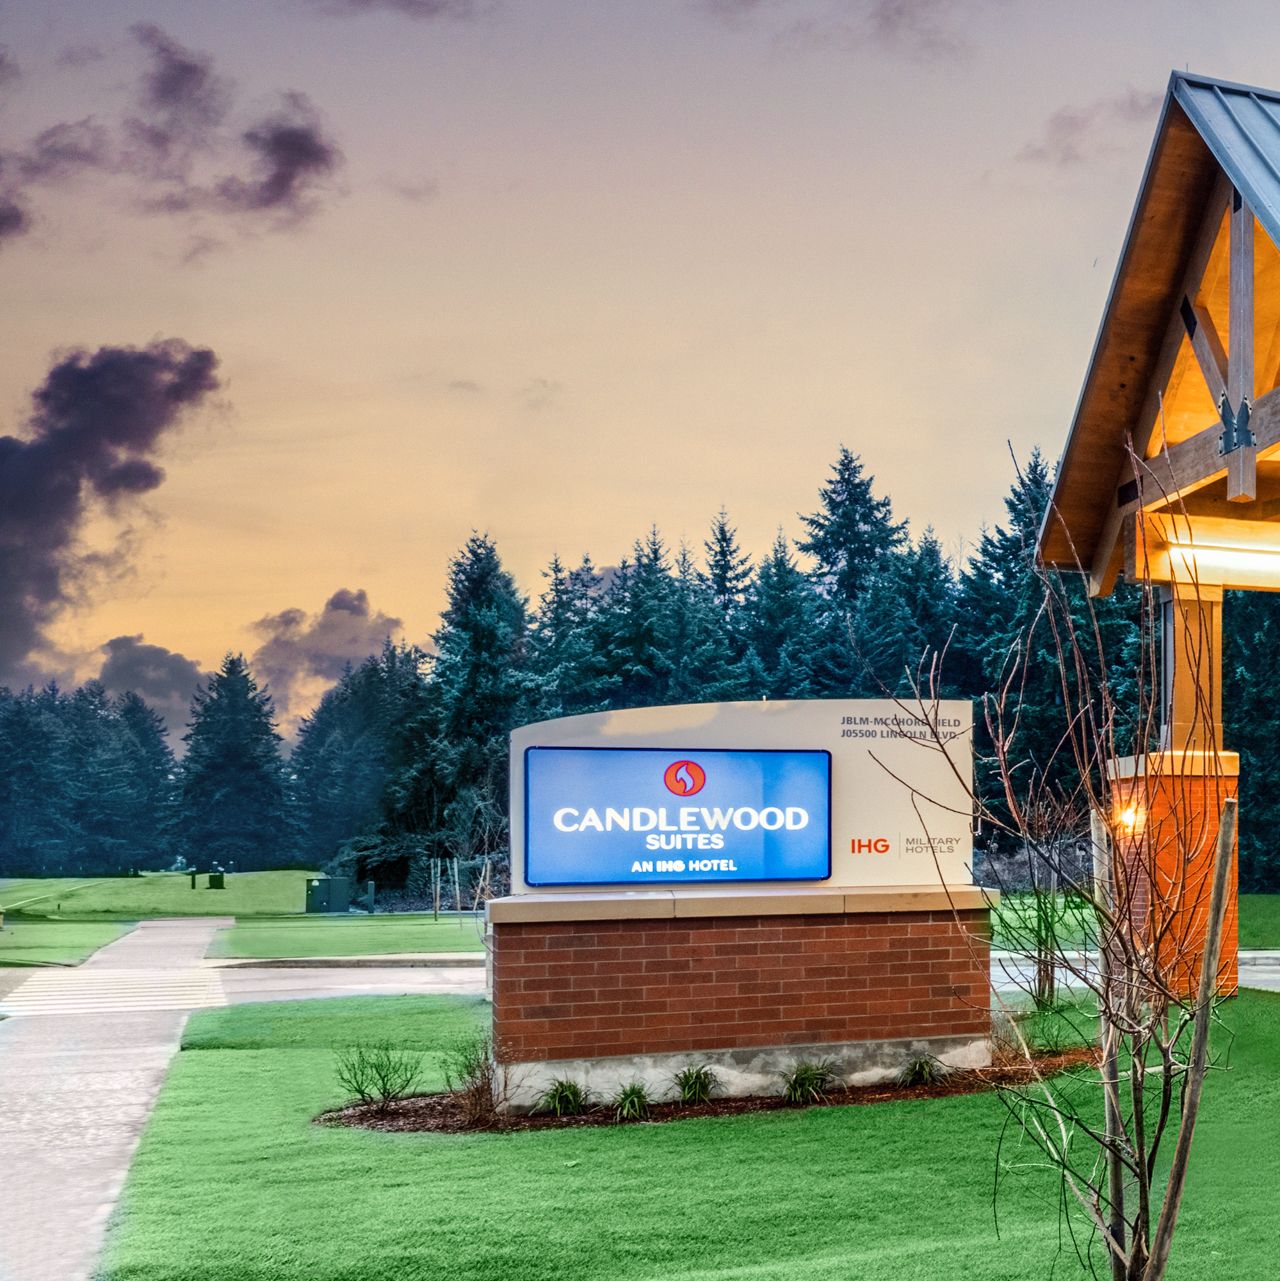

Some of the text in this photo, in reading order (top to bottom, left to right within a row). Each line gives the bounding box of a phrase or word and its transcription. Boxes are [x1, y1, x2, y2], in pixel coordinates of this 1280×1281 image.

[932, 718, 961, 728] IELD
[841, 729, 877, 739] J05500
[553, 807, 809, 832] CANDLEWOOD
[645, 834, 725, 850] SUITES
[851, 838, 890, 854] IHG
[905, 837, 961, 846] MILITARY
[905, 845, 955, 854] HOTELS
[631, 859, 738, 873] AN IHG HOTEL
